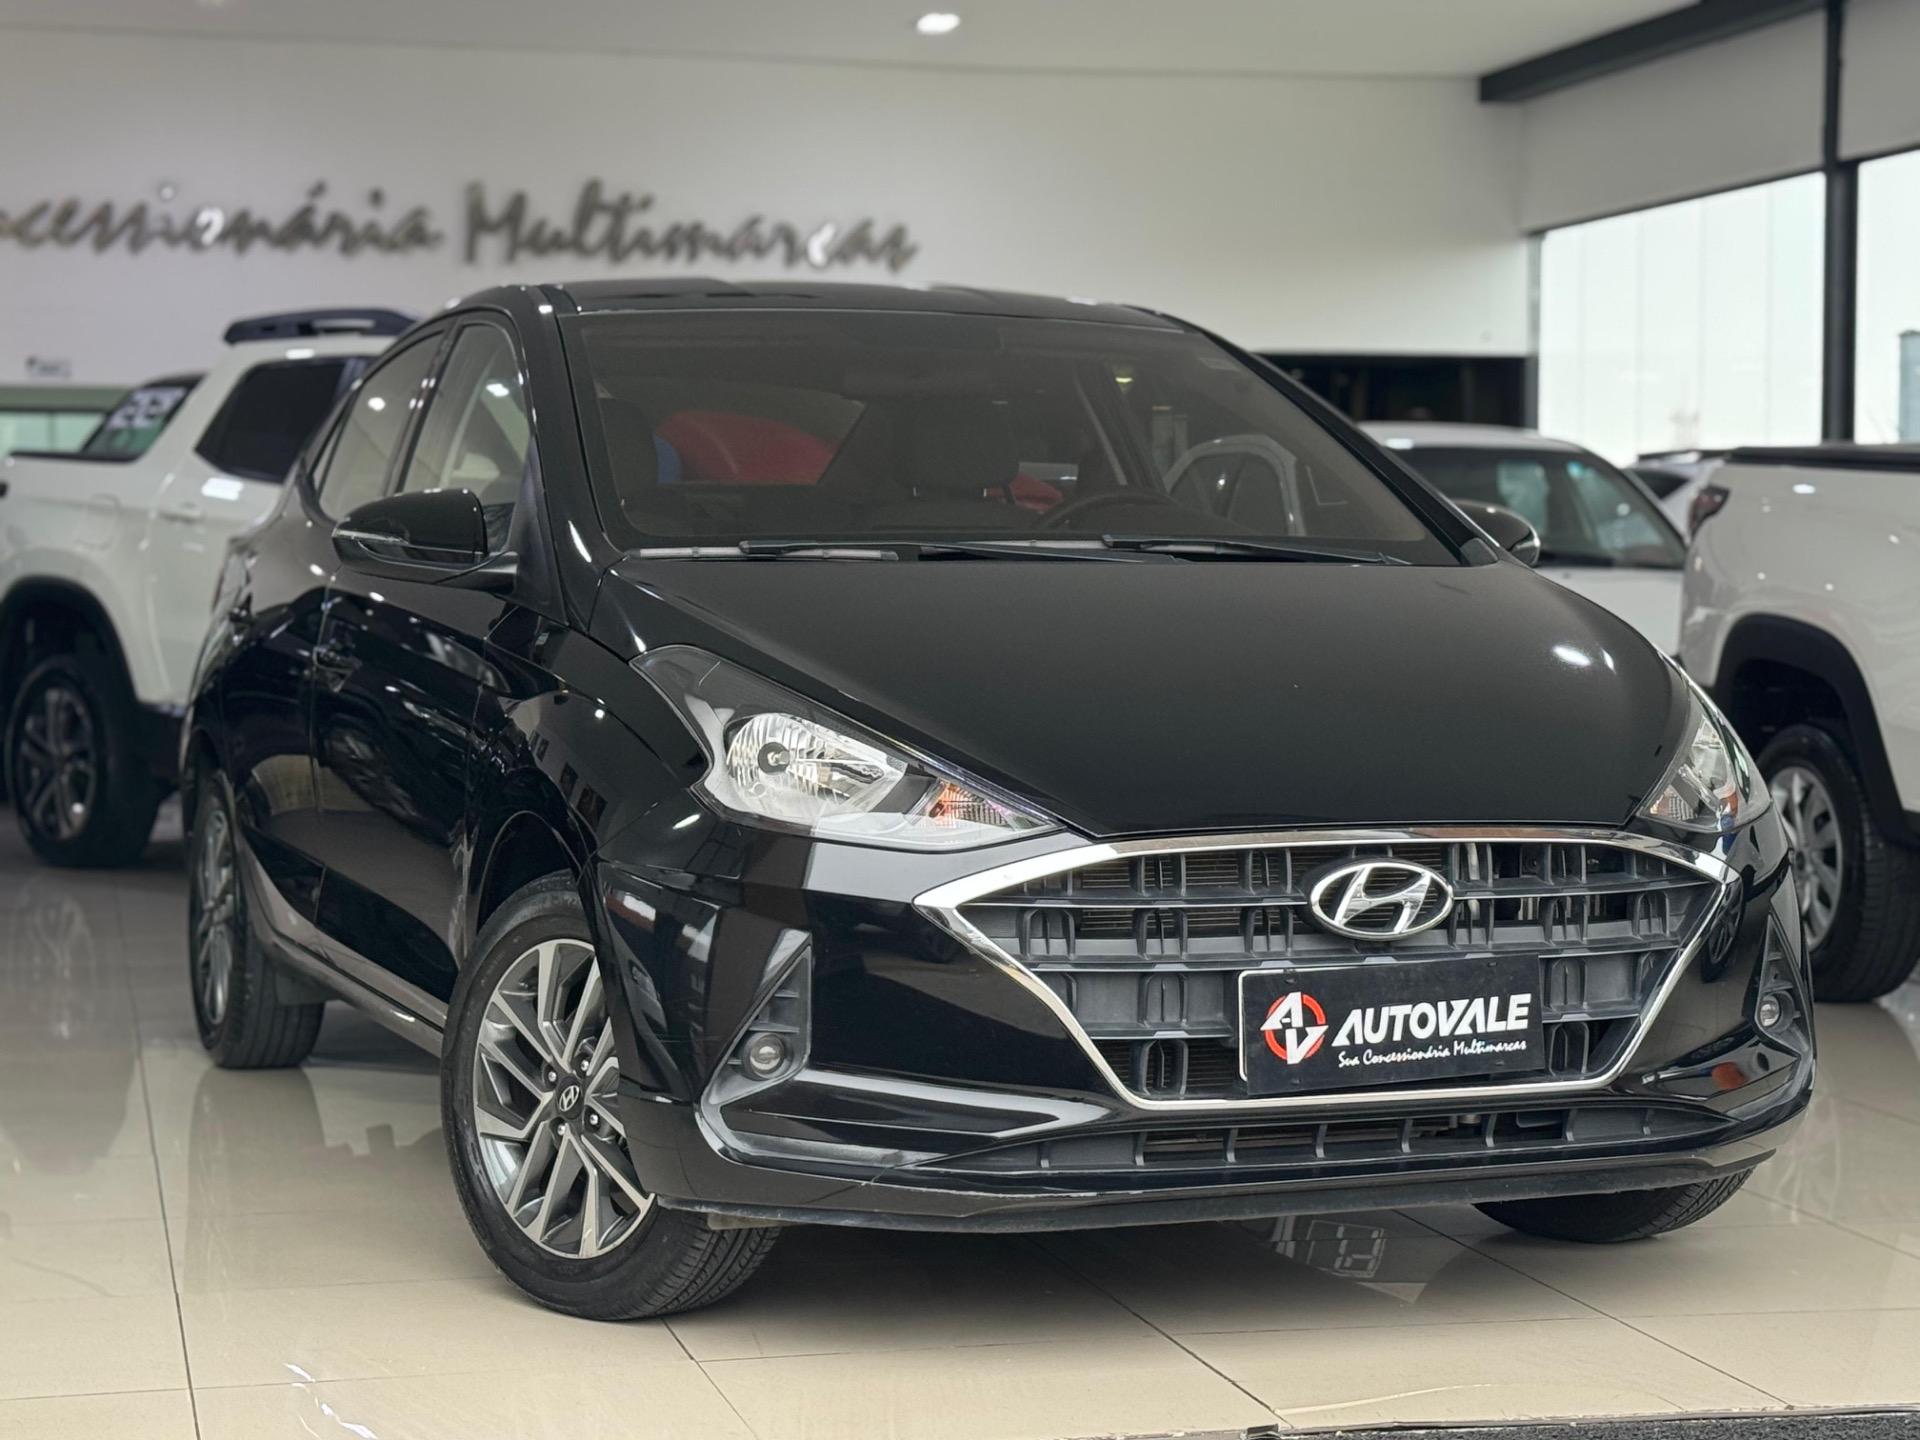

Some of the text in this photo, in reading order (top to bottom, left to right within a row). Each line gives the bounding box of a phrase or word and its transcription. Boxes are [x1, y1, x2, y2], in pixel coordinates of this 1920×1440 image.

[0, 176, 918, 272] cessionária Multimarcas
[1331, 993, 1532, 1047] AUTOVALE
[1338, 1051, 1360, 1068] Sua
[1453, 1038, 1527, 1057] Multimarcas
